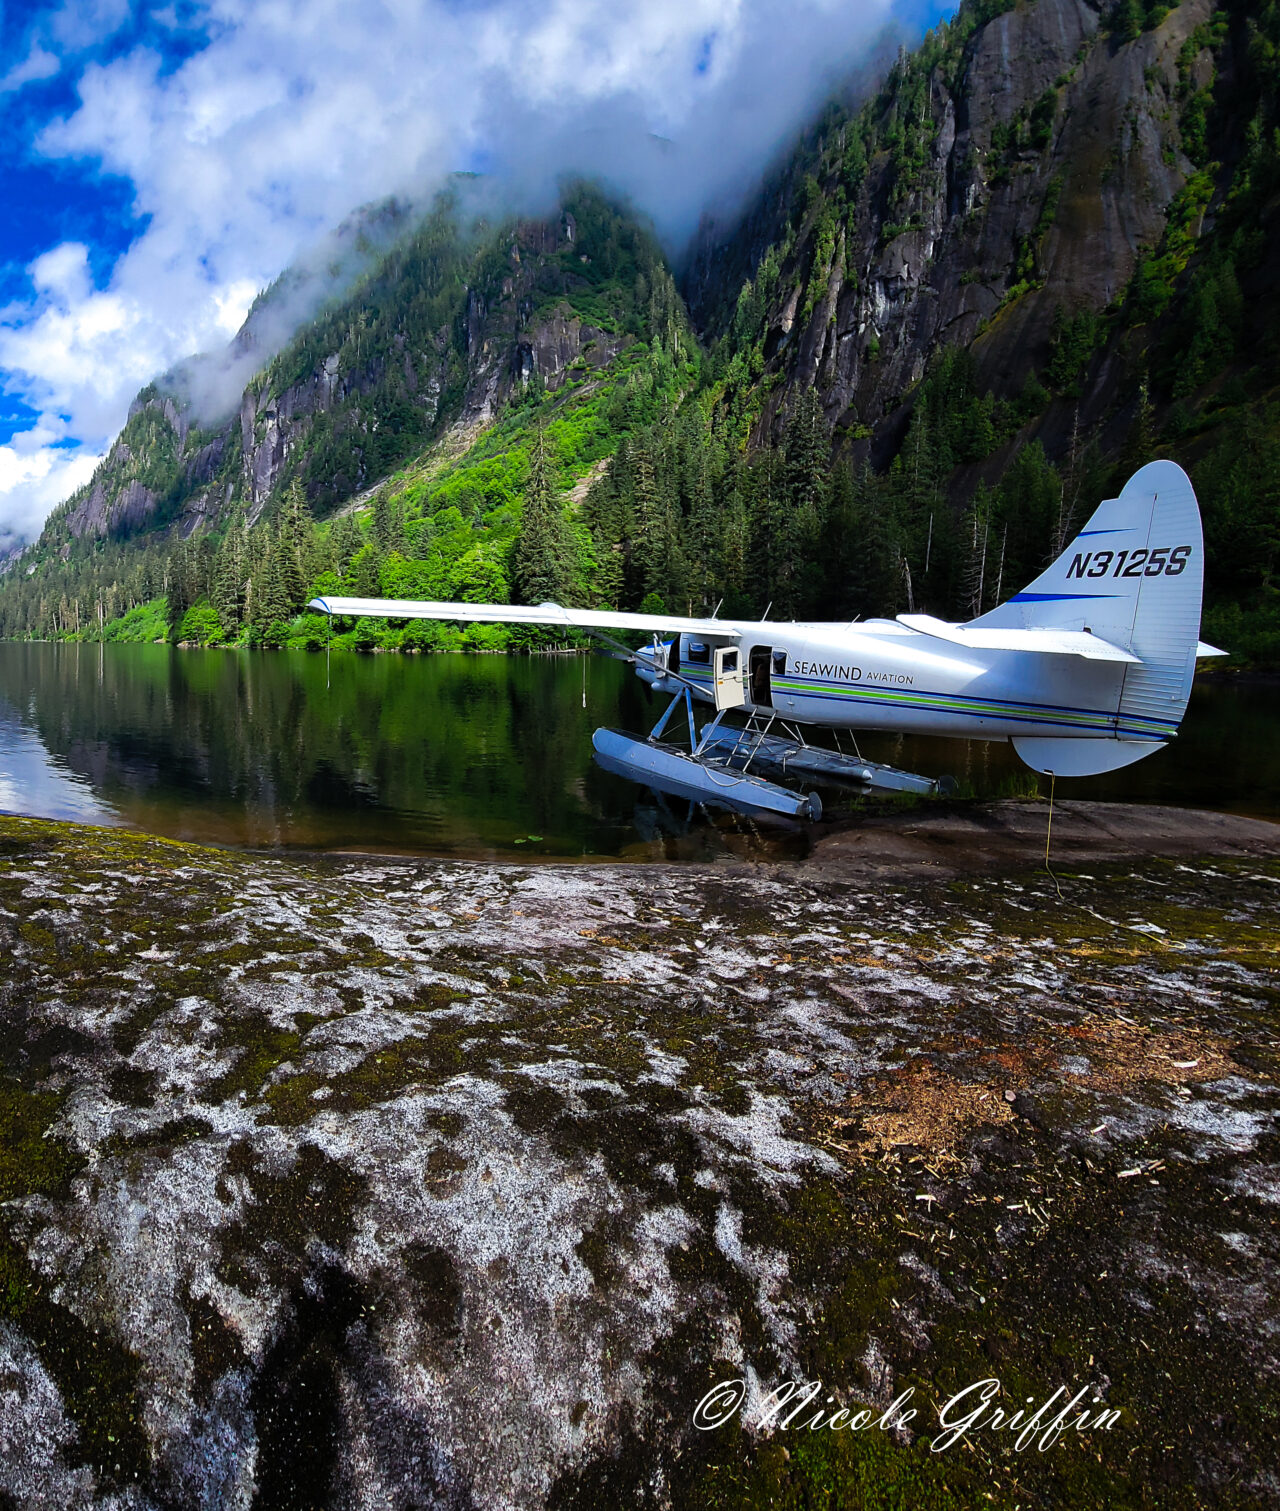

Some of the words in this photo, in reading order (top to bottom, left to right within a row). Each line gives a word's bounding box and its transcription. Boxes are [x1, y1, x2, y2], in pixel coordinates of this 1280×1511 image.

[1066, 545, 1193, 579] N3125S
[794, 660, 862, 681] SEAWIND
[866, 671, 914, 685] AVIATION
